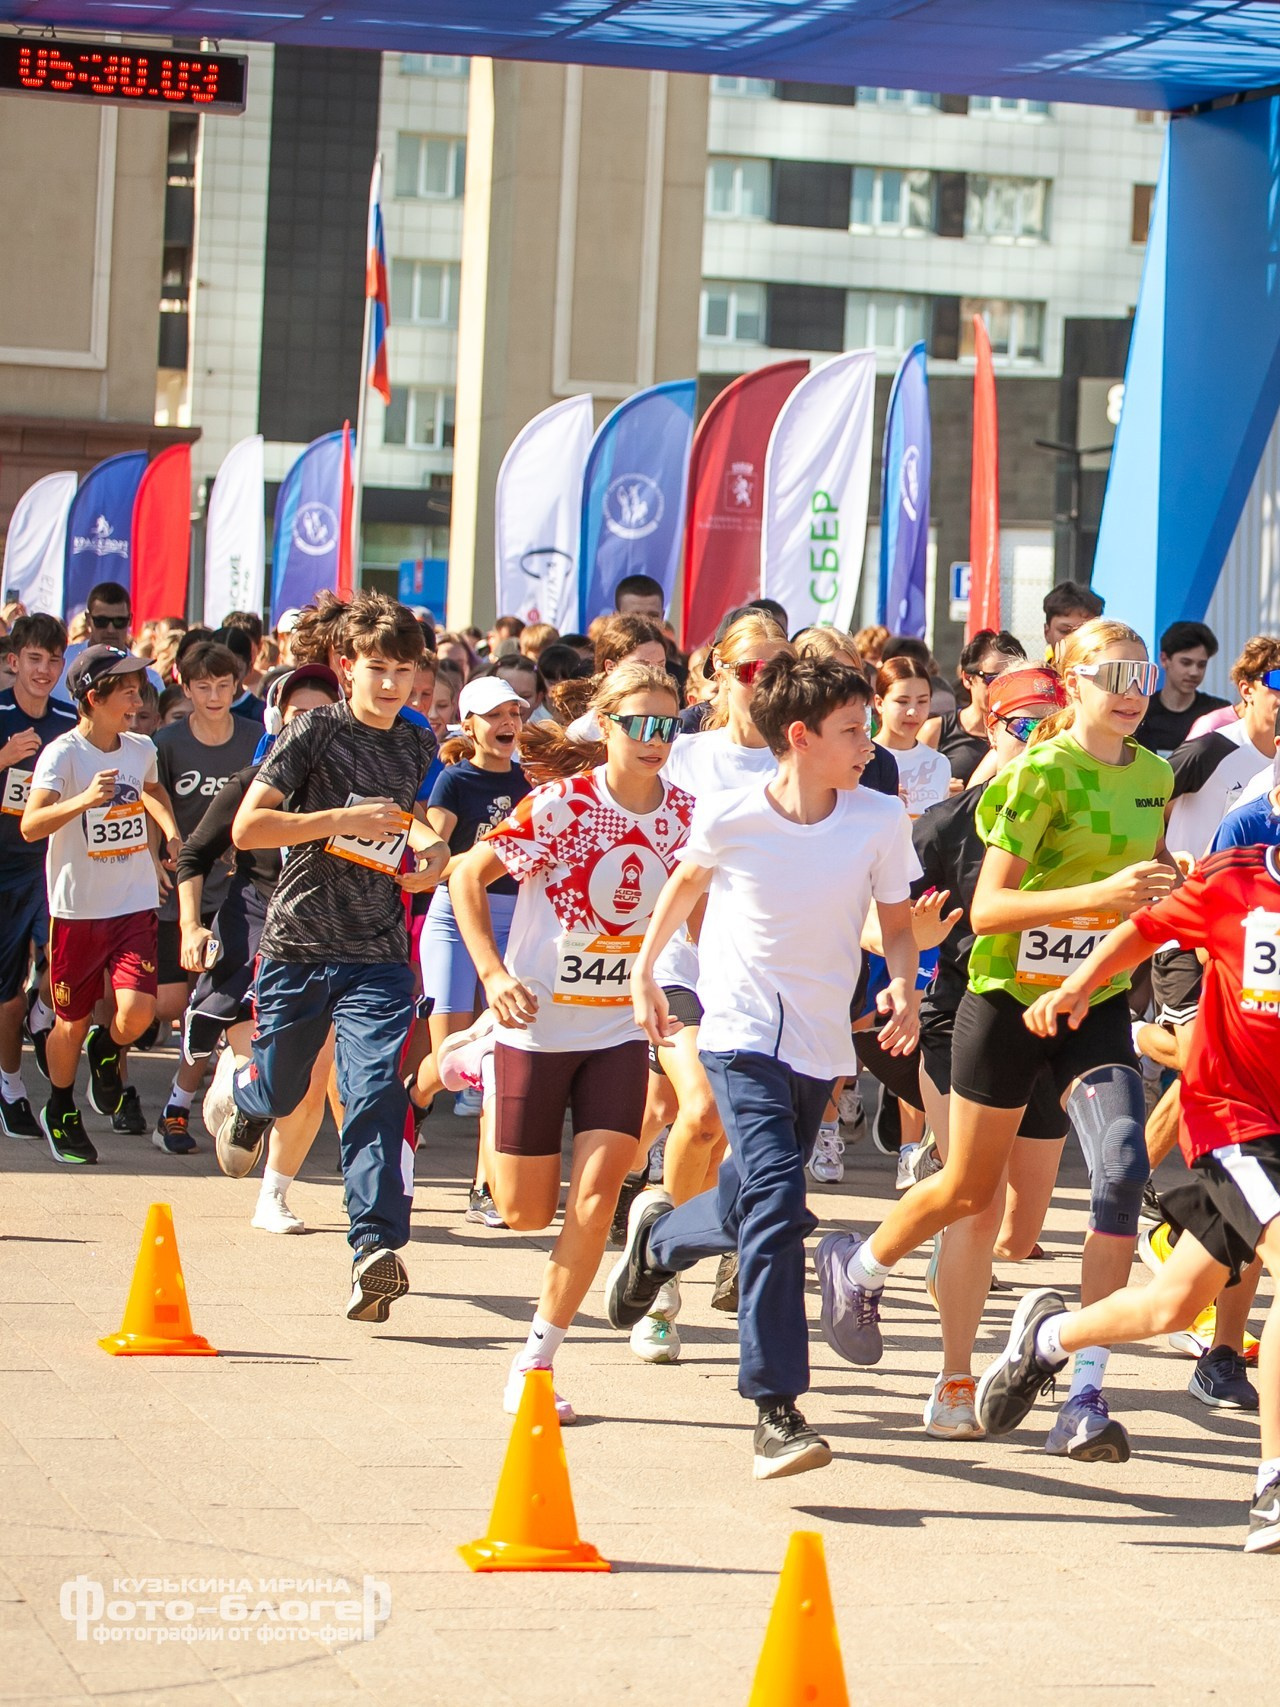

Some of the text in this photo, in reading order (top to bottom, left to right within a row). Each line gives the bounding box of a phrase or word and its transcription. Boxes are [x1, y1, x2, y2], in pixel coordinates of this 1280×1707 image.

[810, 489, 840, 604] СБЕР
[200, 777, 229, 796] as
[93, 817, 144, 844] 3323
[614, 888, 643, 897] KIDS
[1025, 930, 1107, 964] 344
[560, 955, 631, 986] 344
